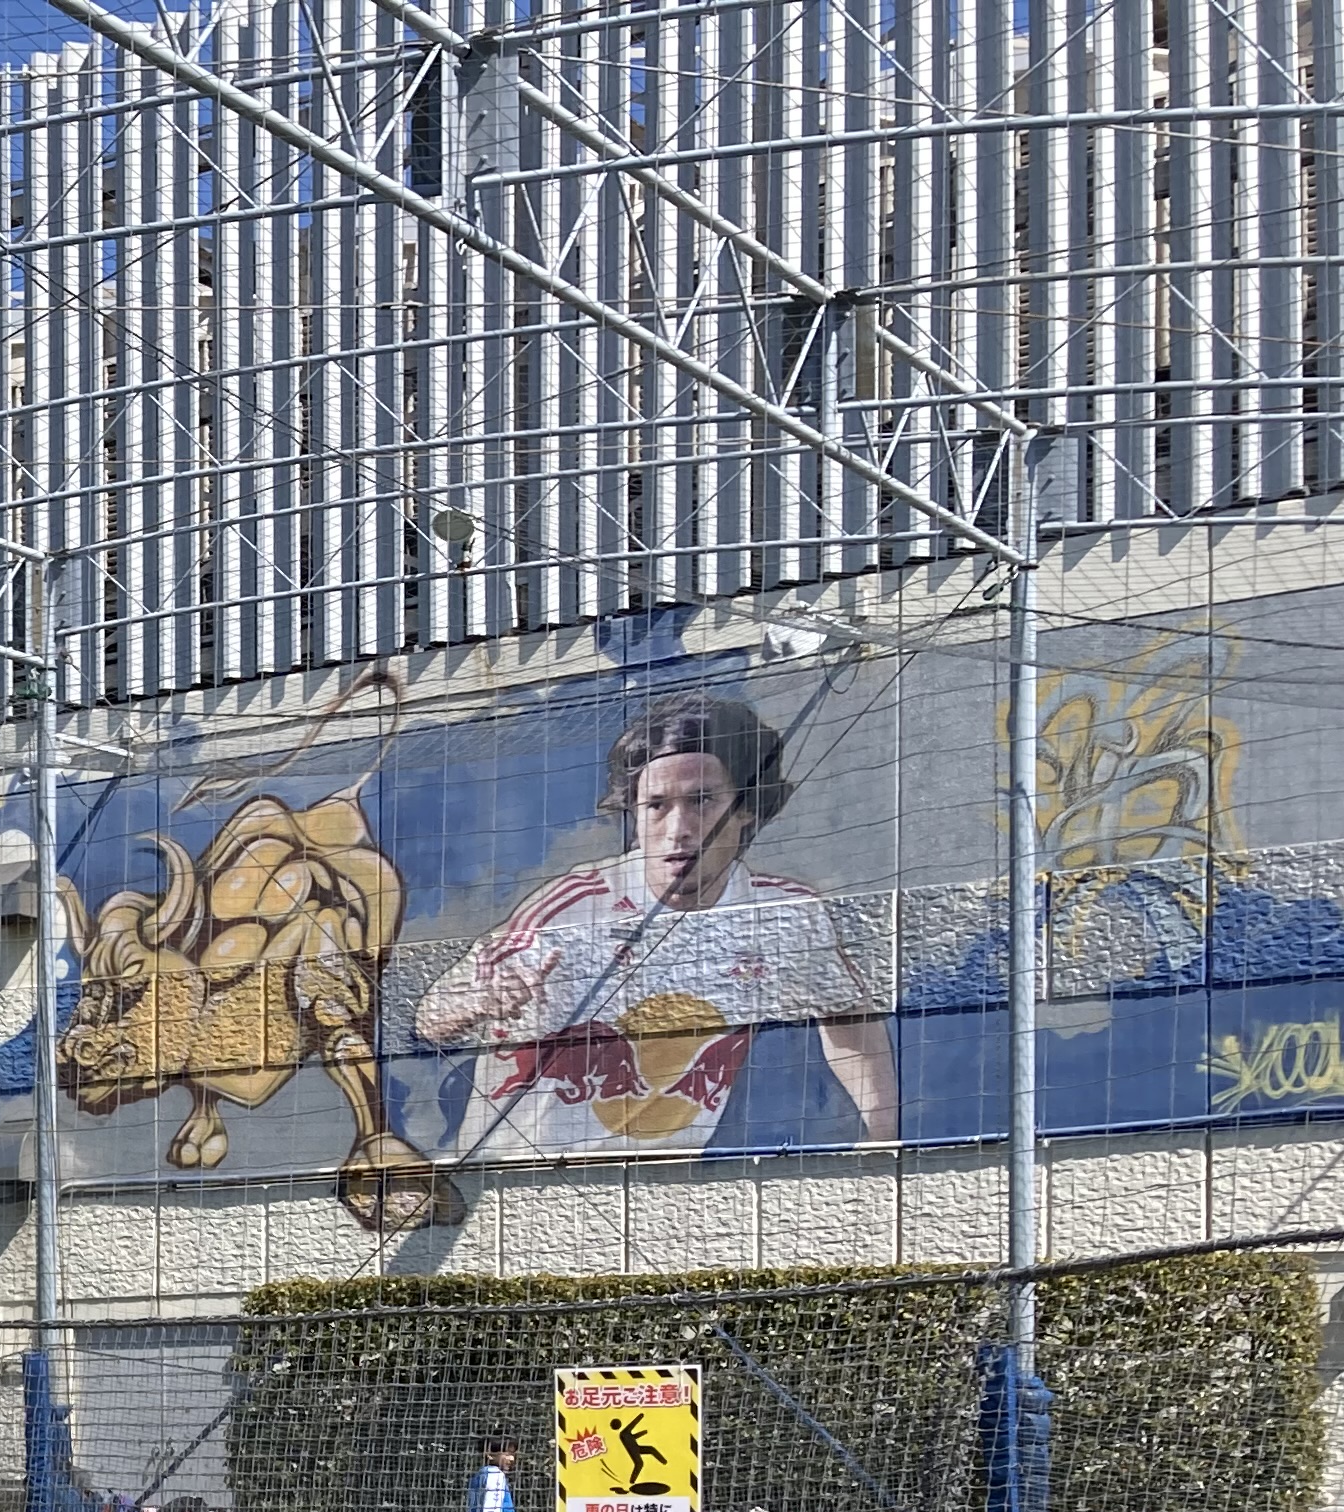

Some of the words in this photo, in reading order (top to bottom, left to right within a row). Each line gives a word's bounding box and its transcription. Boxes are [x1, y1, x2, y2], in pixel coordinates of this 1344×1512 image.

[564, 1385, 692, 1407] お足元ご注意！
[570, 1435, 607, 1463] 危険
